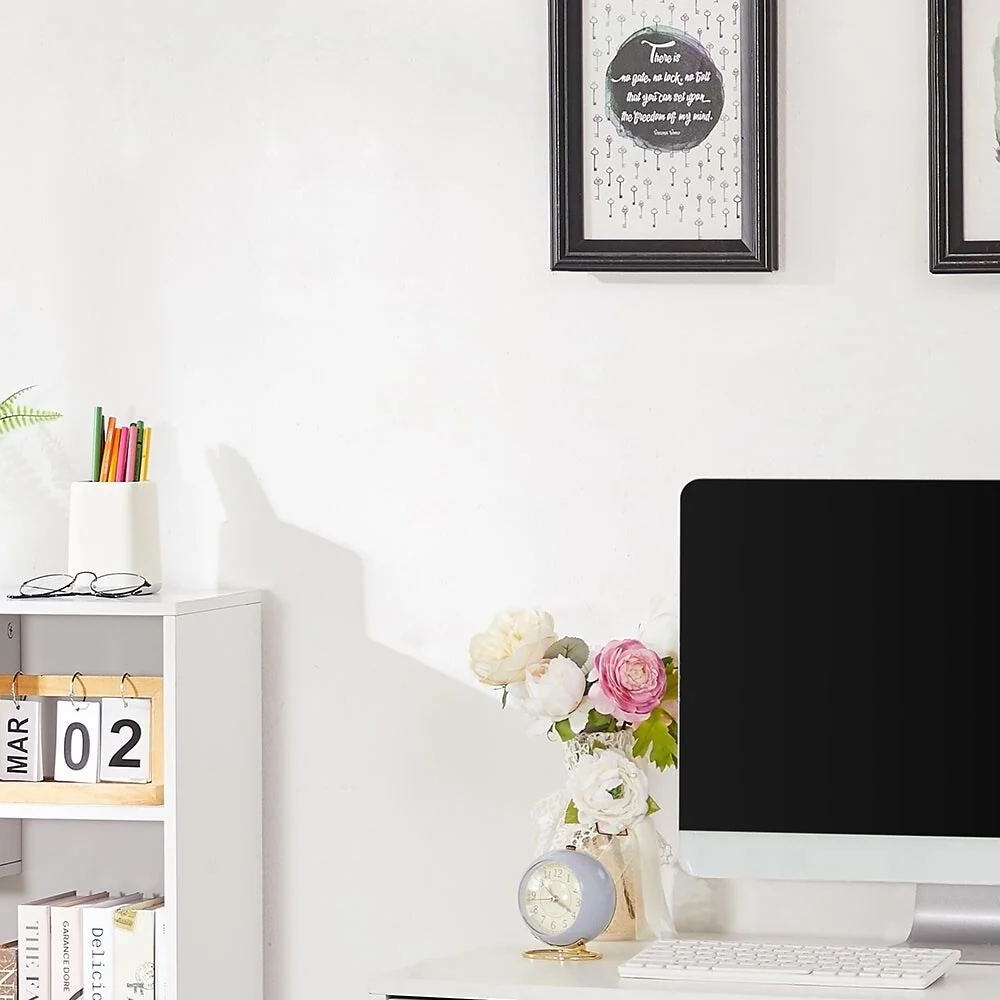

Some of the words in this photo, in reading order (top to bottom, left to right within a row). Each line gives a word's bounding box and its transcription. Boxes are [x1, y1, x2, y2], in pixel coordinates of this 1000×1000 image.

[641, 40, 673, 63] There
[673, 51, 680, 63] is
[626, 91, 641, 102] that
[642, 92, 657, 107] you
[673, 91, 686, 102] set
[621, 110, 633, 122] the
[633, 110, 666, 125] freedom
[6, 717, 29, 774] MAR
[25, 920, 40, 968] THE
[62, 920, 70, 966] GARANCE
